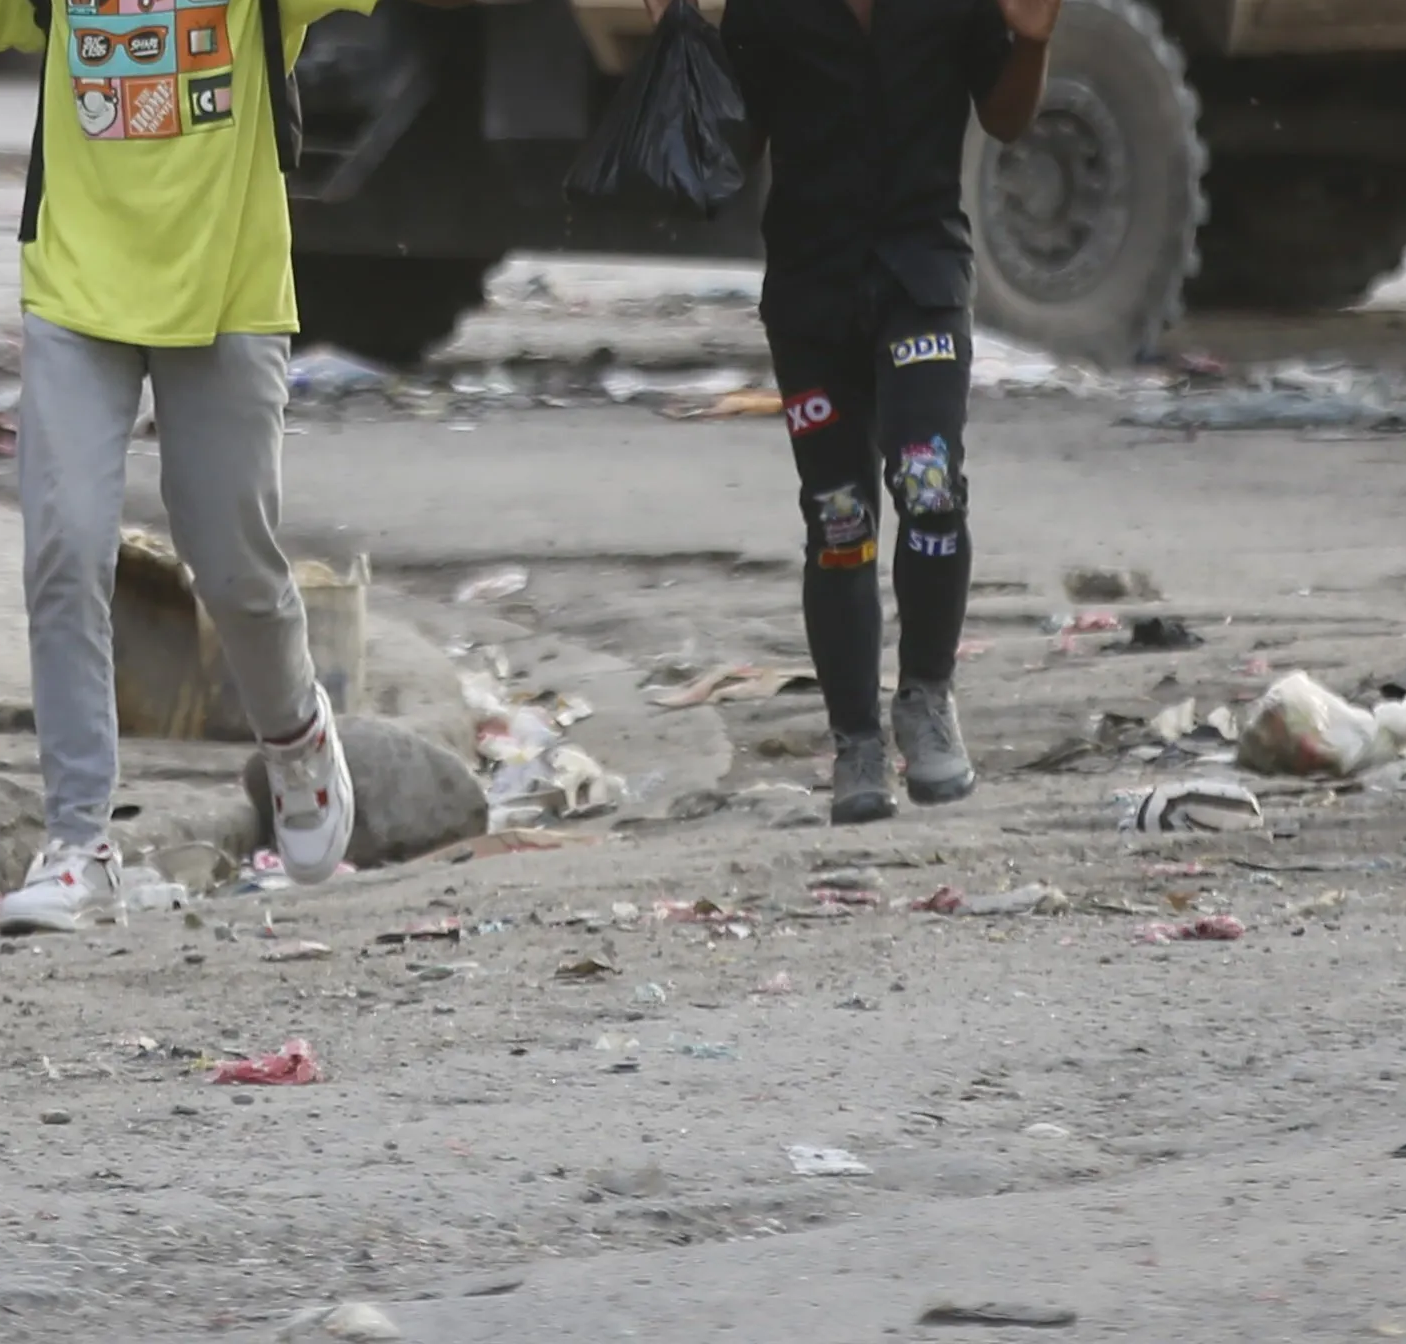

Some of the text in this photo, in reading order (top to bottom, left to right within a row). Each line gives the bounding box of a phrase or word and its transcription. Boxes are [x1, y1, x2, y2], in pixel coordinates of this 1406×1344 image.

[130, 80, 171, 133] HOME
[893, 332, 954, 362] ODR
[788, 396, 833, 431] XO
[908, 529, 958, 555] STE
